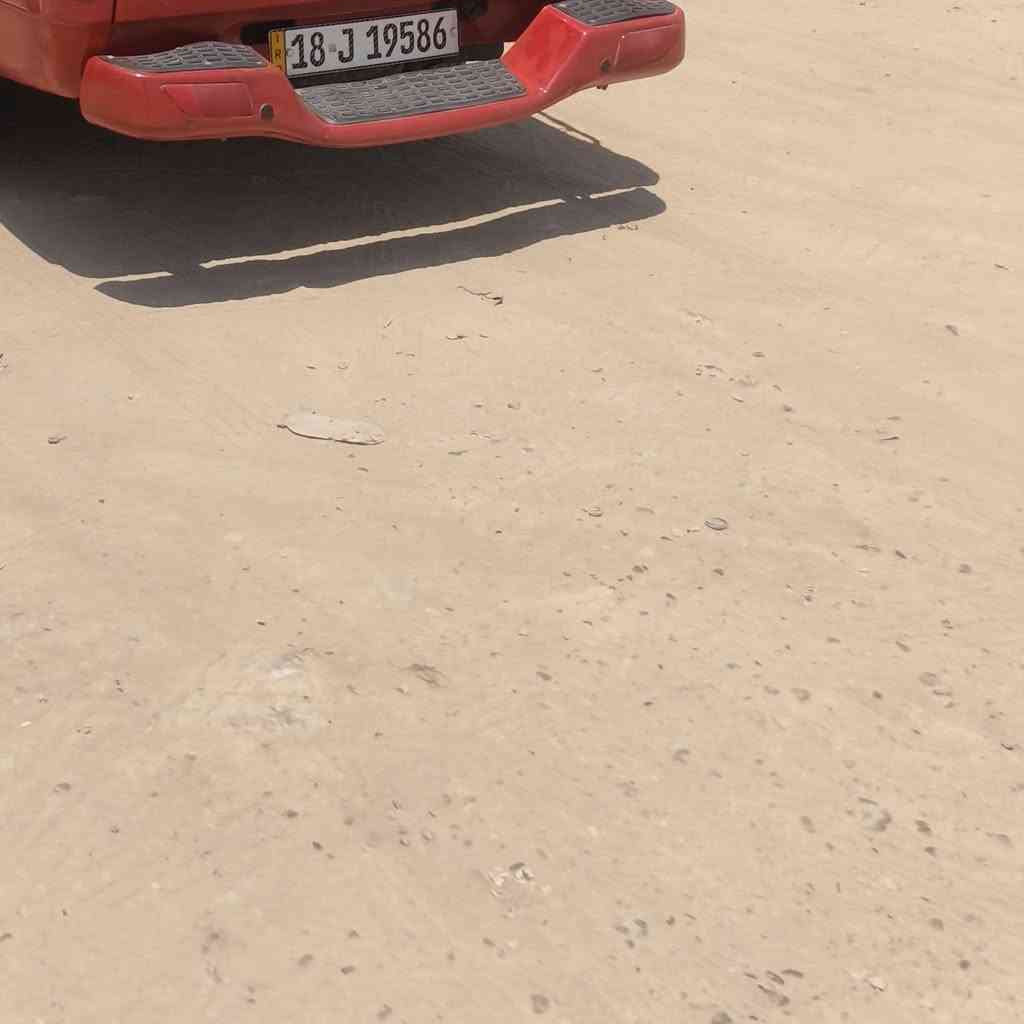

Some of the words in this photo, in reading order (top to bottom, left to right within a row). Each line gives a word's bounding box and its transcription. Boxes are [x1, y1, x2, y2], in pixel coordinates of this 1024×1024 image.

[290, 31, 326, 70] 18
[337, 28, 355, 64] J
[365, 16, 448, 60] 19586
